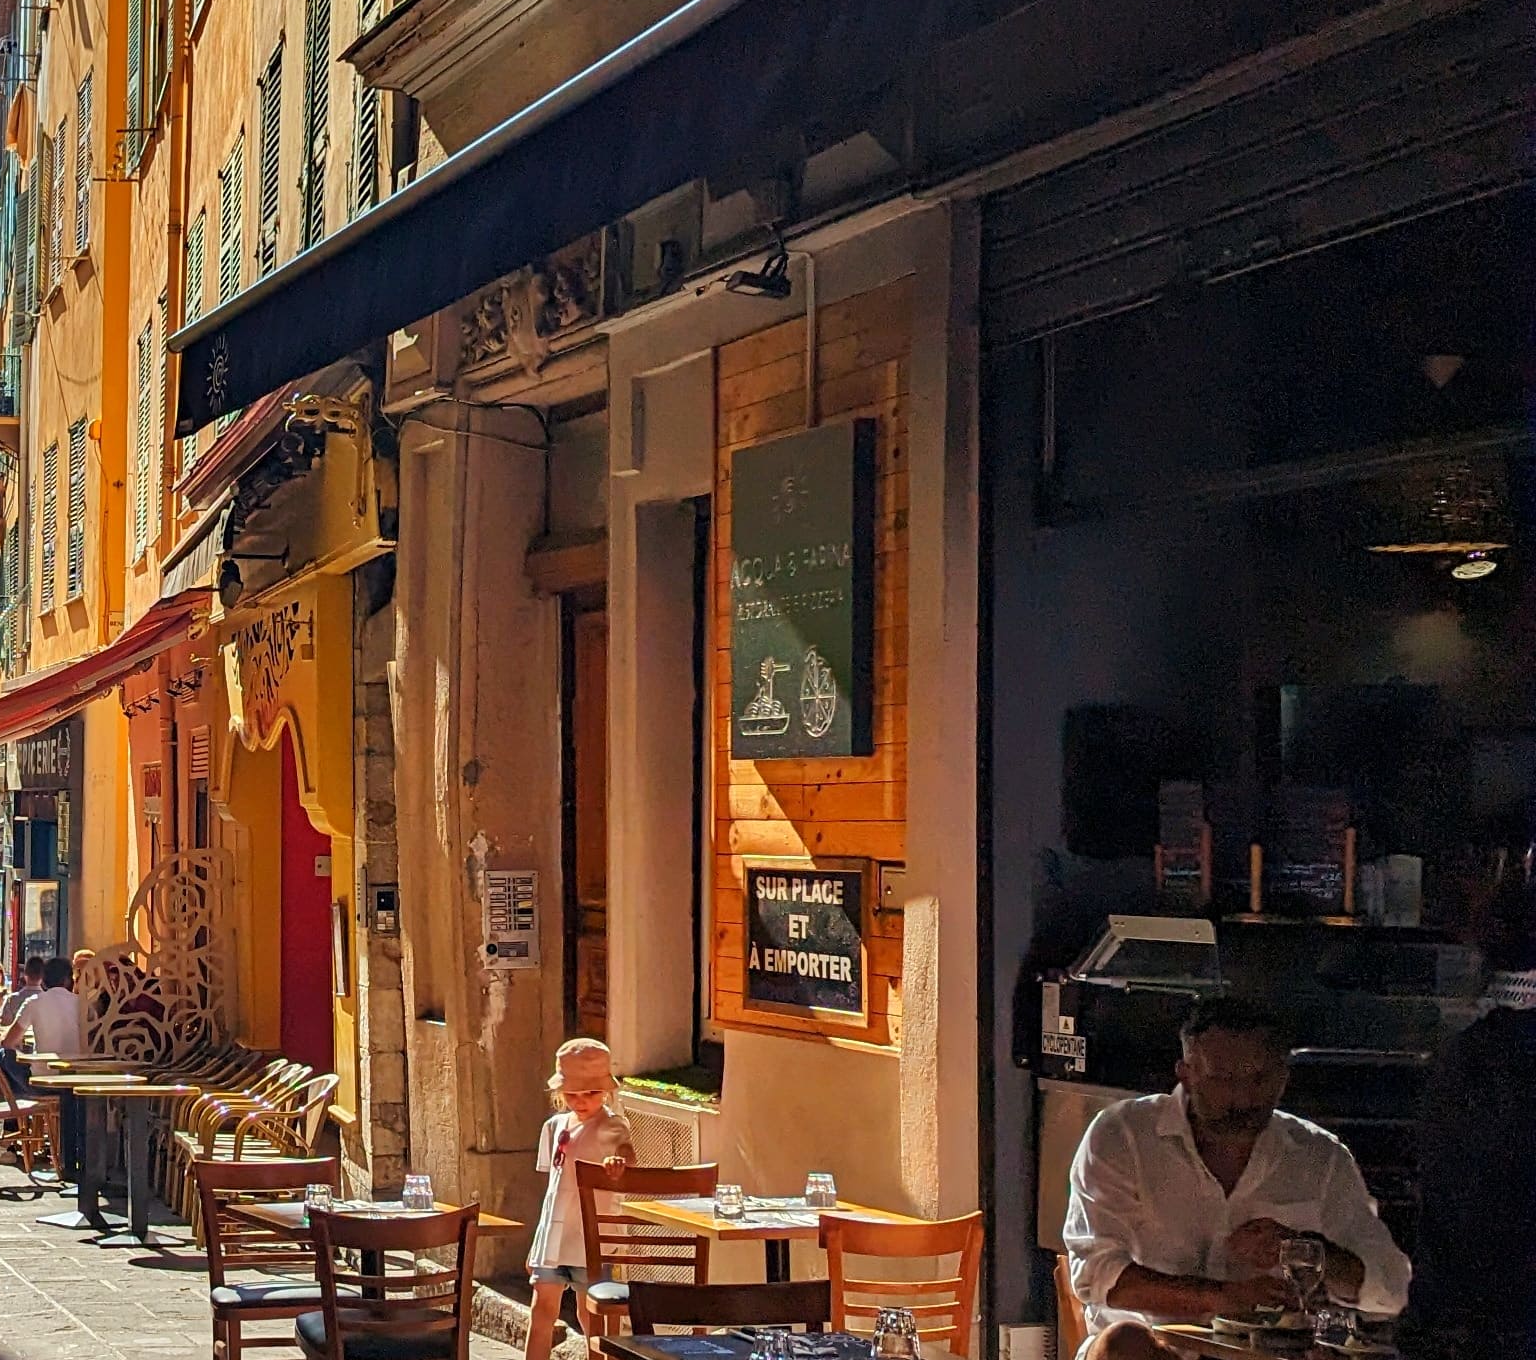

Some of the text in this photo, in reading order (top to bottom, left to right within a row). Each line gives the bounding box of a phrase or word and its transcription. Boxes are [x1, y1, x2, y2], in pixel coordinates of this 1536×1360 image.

[756, 876, 844, 905] SUR PLACE
[789, 914, 810, 939] ET
[749, 941, 853, 982] À EMPORTER
